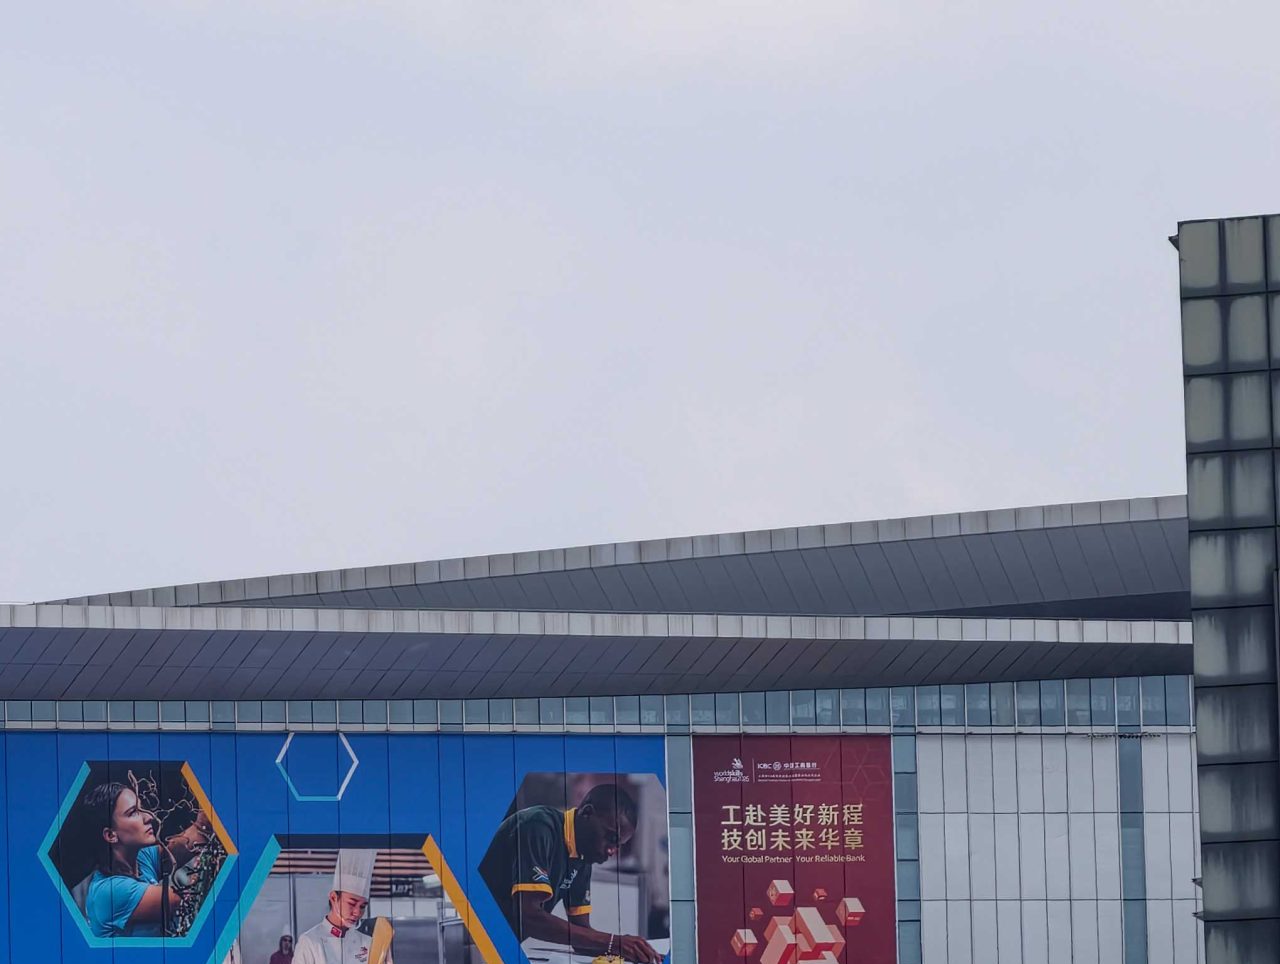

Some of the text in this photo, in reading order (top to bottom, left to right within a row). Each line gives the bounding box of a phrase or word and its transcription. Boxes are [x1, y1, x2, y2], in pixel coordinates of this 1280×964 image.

[720, 803, 864, 827] 工赴美好新程
[721, 827, 864, 851] 技创未来华章
[722, 854, 866, 865] Your Global Partner Your Reliable Bank
